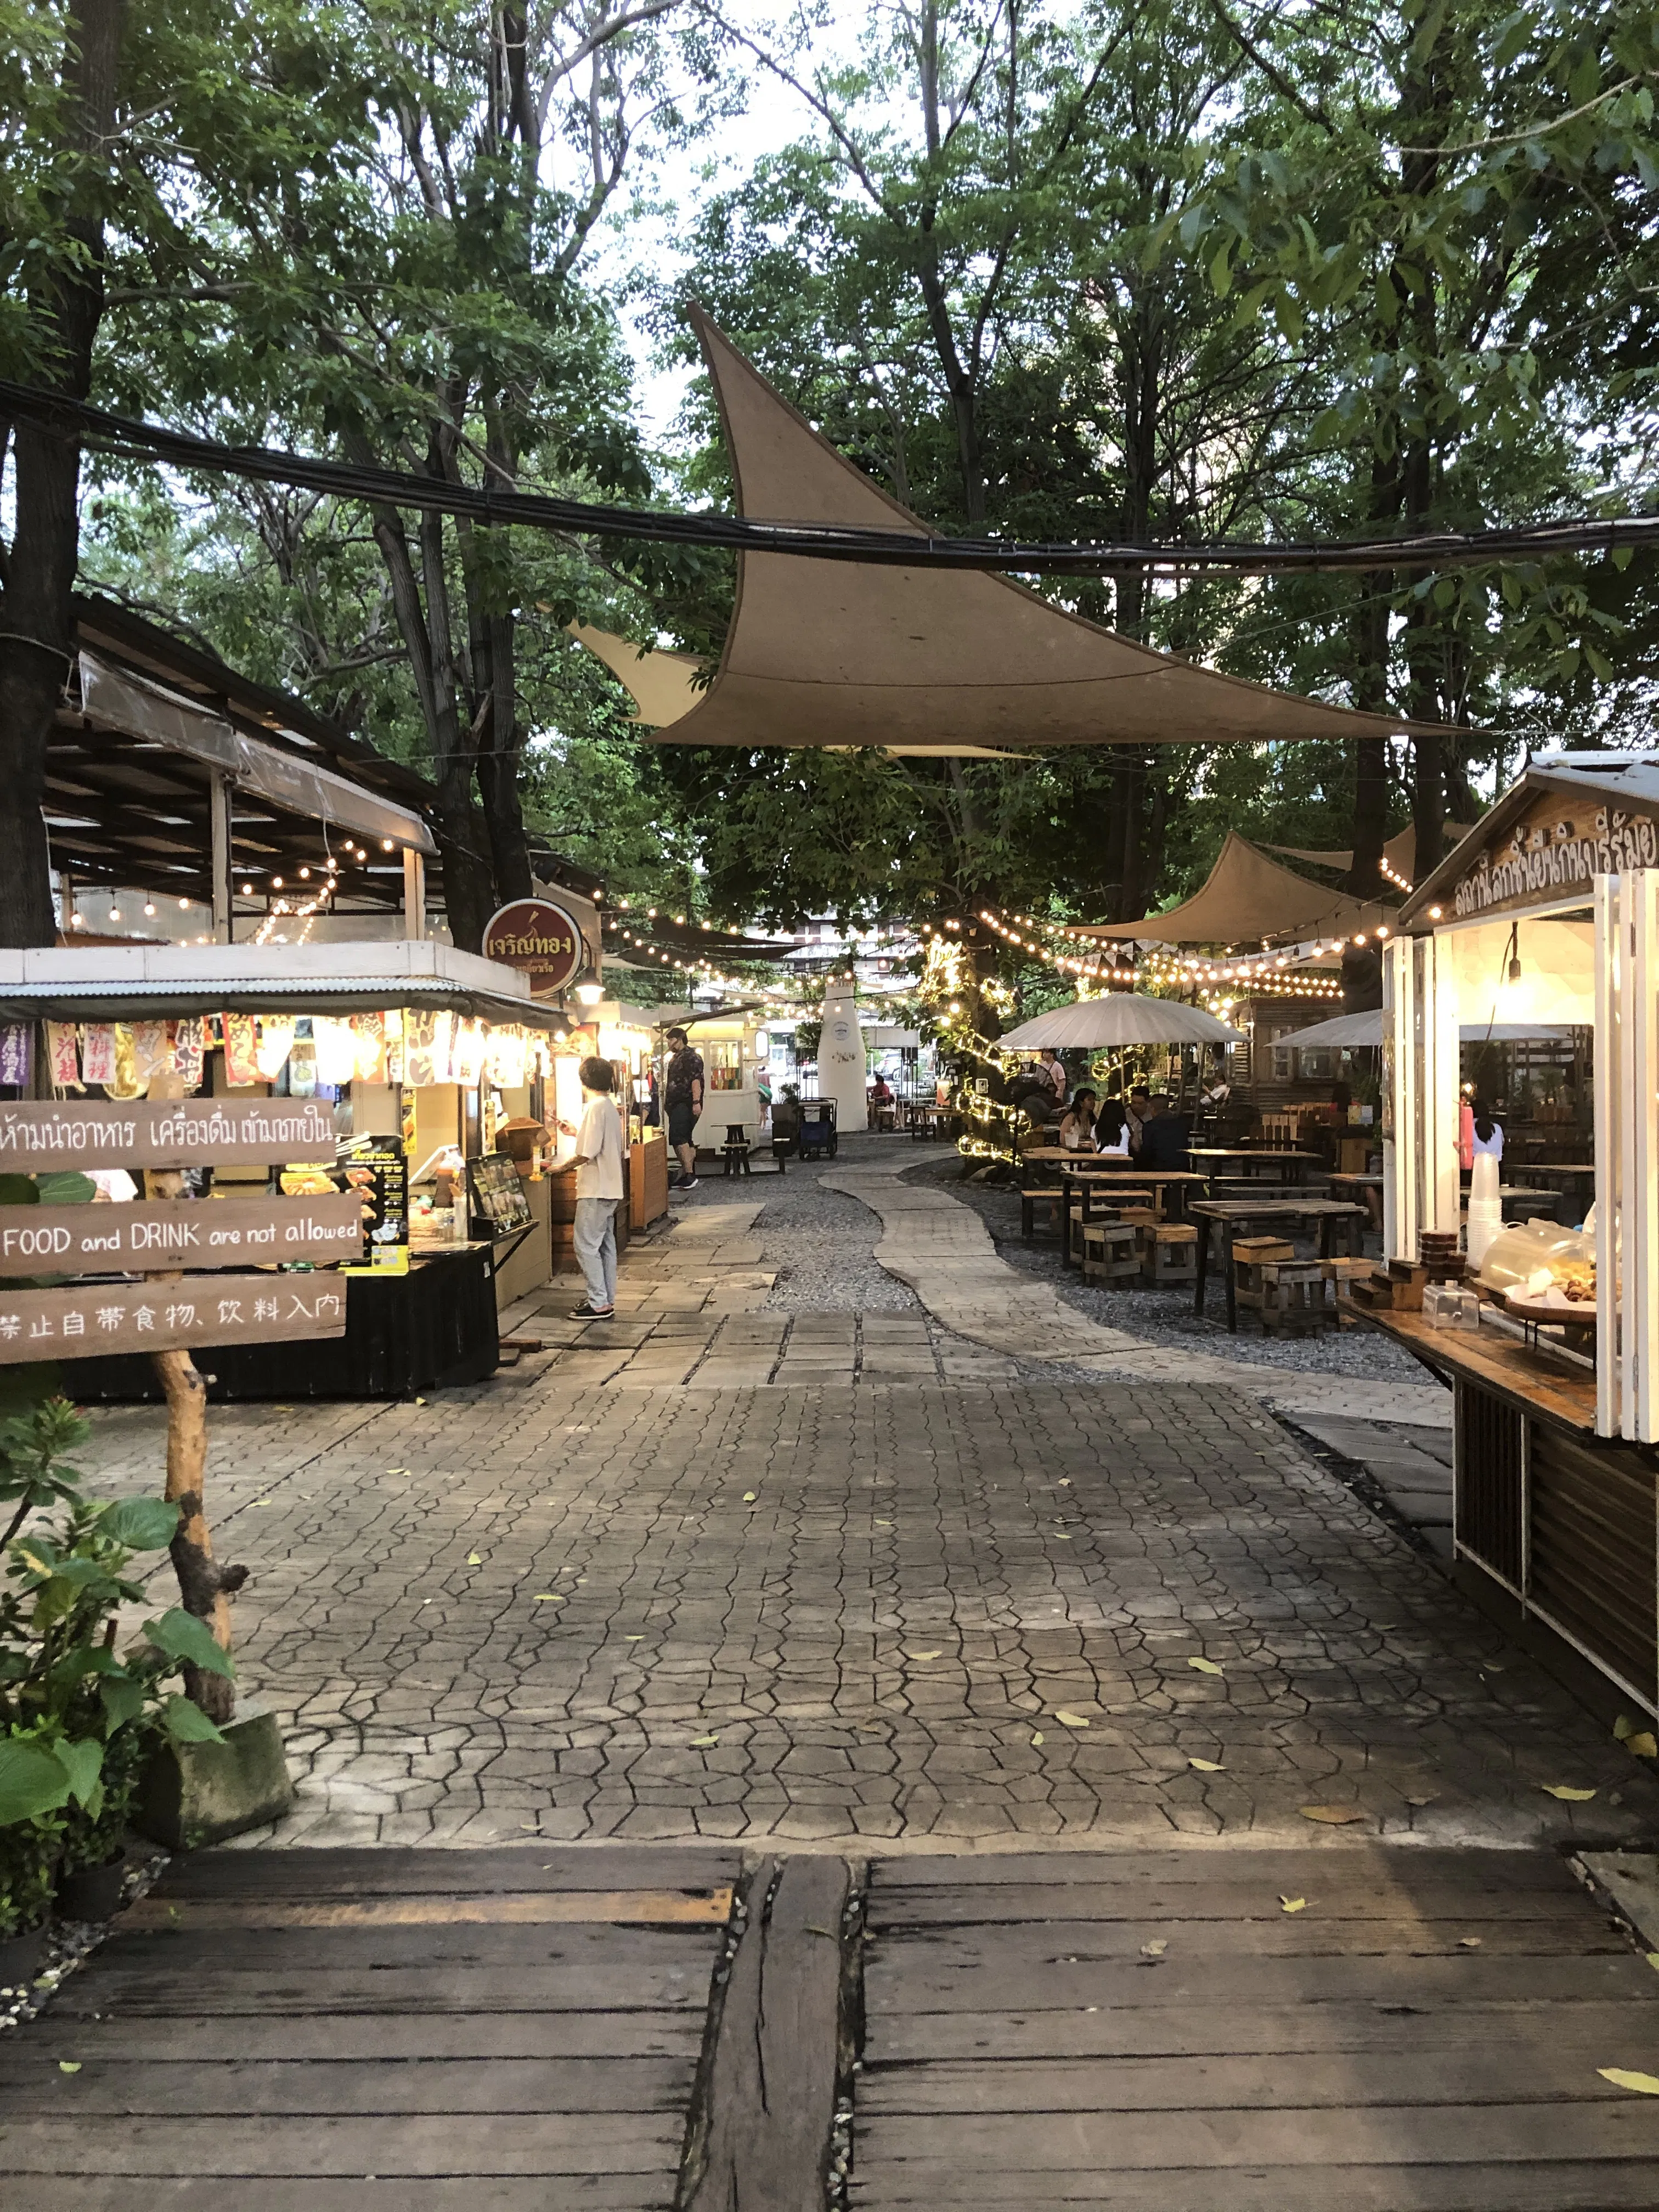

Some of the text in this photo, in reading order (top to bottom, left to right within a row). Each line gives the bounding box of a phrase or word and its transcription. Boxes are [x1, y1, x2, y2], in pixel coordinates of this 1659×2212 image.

[489, 933, 571, 956] เจริญทอง
[0, 1113, 137, 1151] ห้ามนำอาหาร
[3, 1217, 358, 1256] FOOD and DRINK are not allowed
